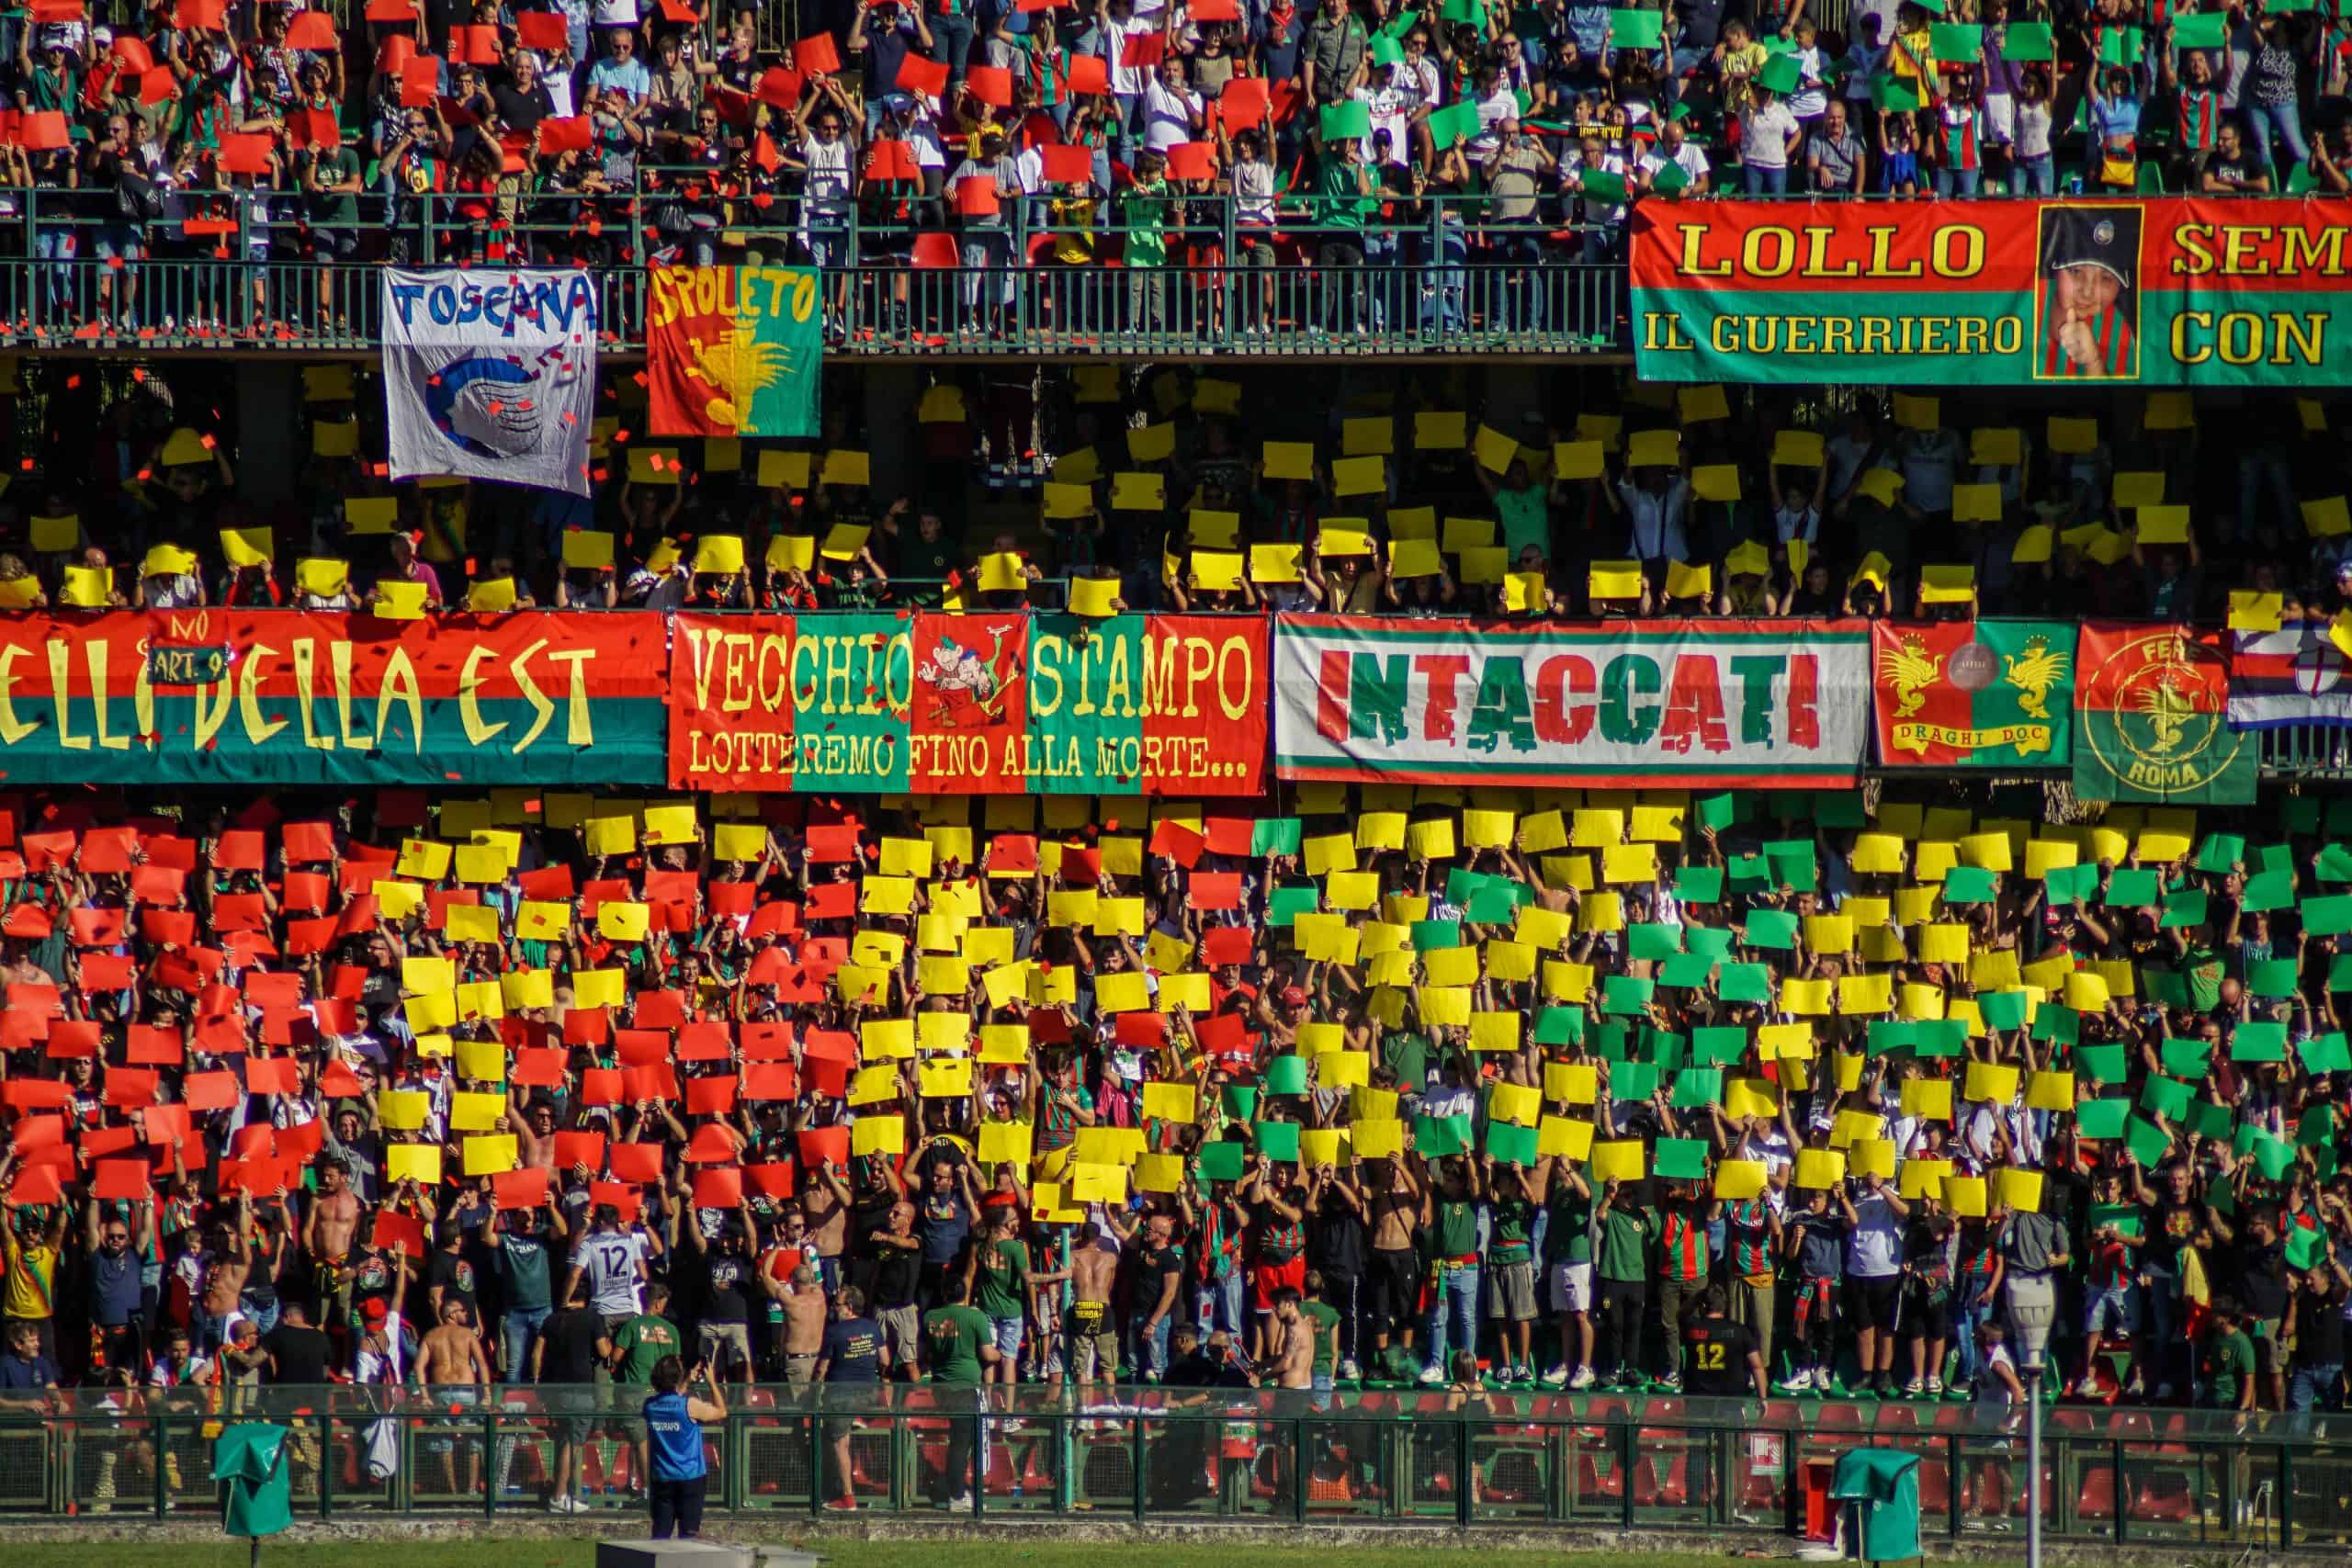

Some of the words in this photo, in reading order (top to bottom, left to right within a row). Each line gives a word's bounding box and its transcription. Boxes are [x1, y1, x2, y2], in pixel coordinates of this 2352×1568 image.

[1676, 223, 1986, 278] LOLLO
[2172, 222, 2351, 276] SEM
[392, 275, 597, 337] TOSCANA
[652, 265, 816, 327] SPOLETO
[1643, 312, 1694, 351] IL
[1712, 314, 2023, 355] GUERRIERO
[2169, 310, 2326, 365] CON
[171, 610, 209, 642] NO
[153, 650, 199, 682] ART.
[208, 653, 224, 677] 9
[687, 628, 915, 715] VECCHIO
[1030, 632, 1252, 720] STAMPO
[458, 638, 596, 755] EST
[1317, 649, 1820, 755] INTACCATI
[689, 730, 894, 778] LOTTEREMO
[906, 733, 989, 778] FINO
[1000, 733, 1083, 777] ALLA
[1095, 735, 1247, 778] MORTE...
[1900, 725, 1984, 746] DRAGHI
[2128, 761, 2200, 786] ROMA
[600, 1245, 628, 1279] 12
[1696, 1343, 1725, 1370] 12
